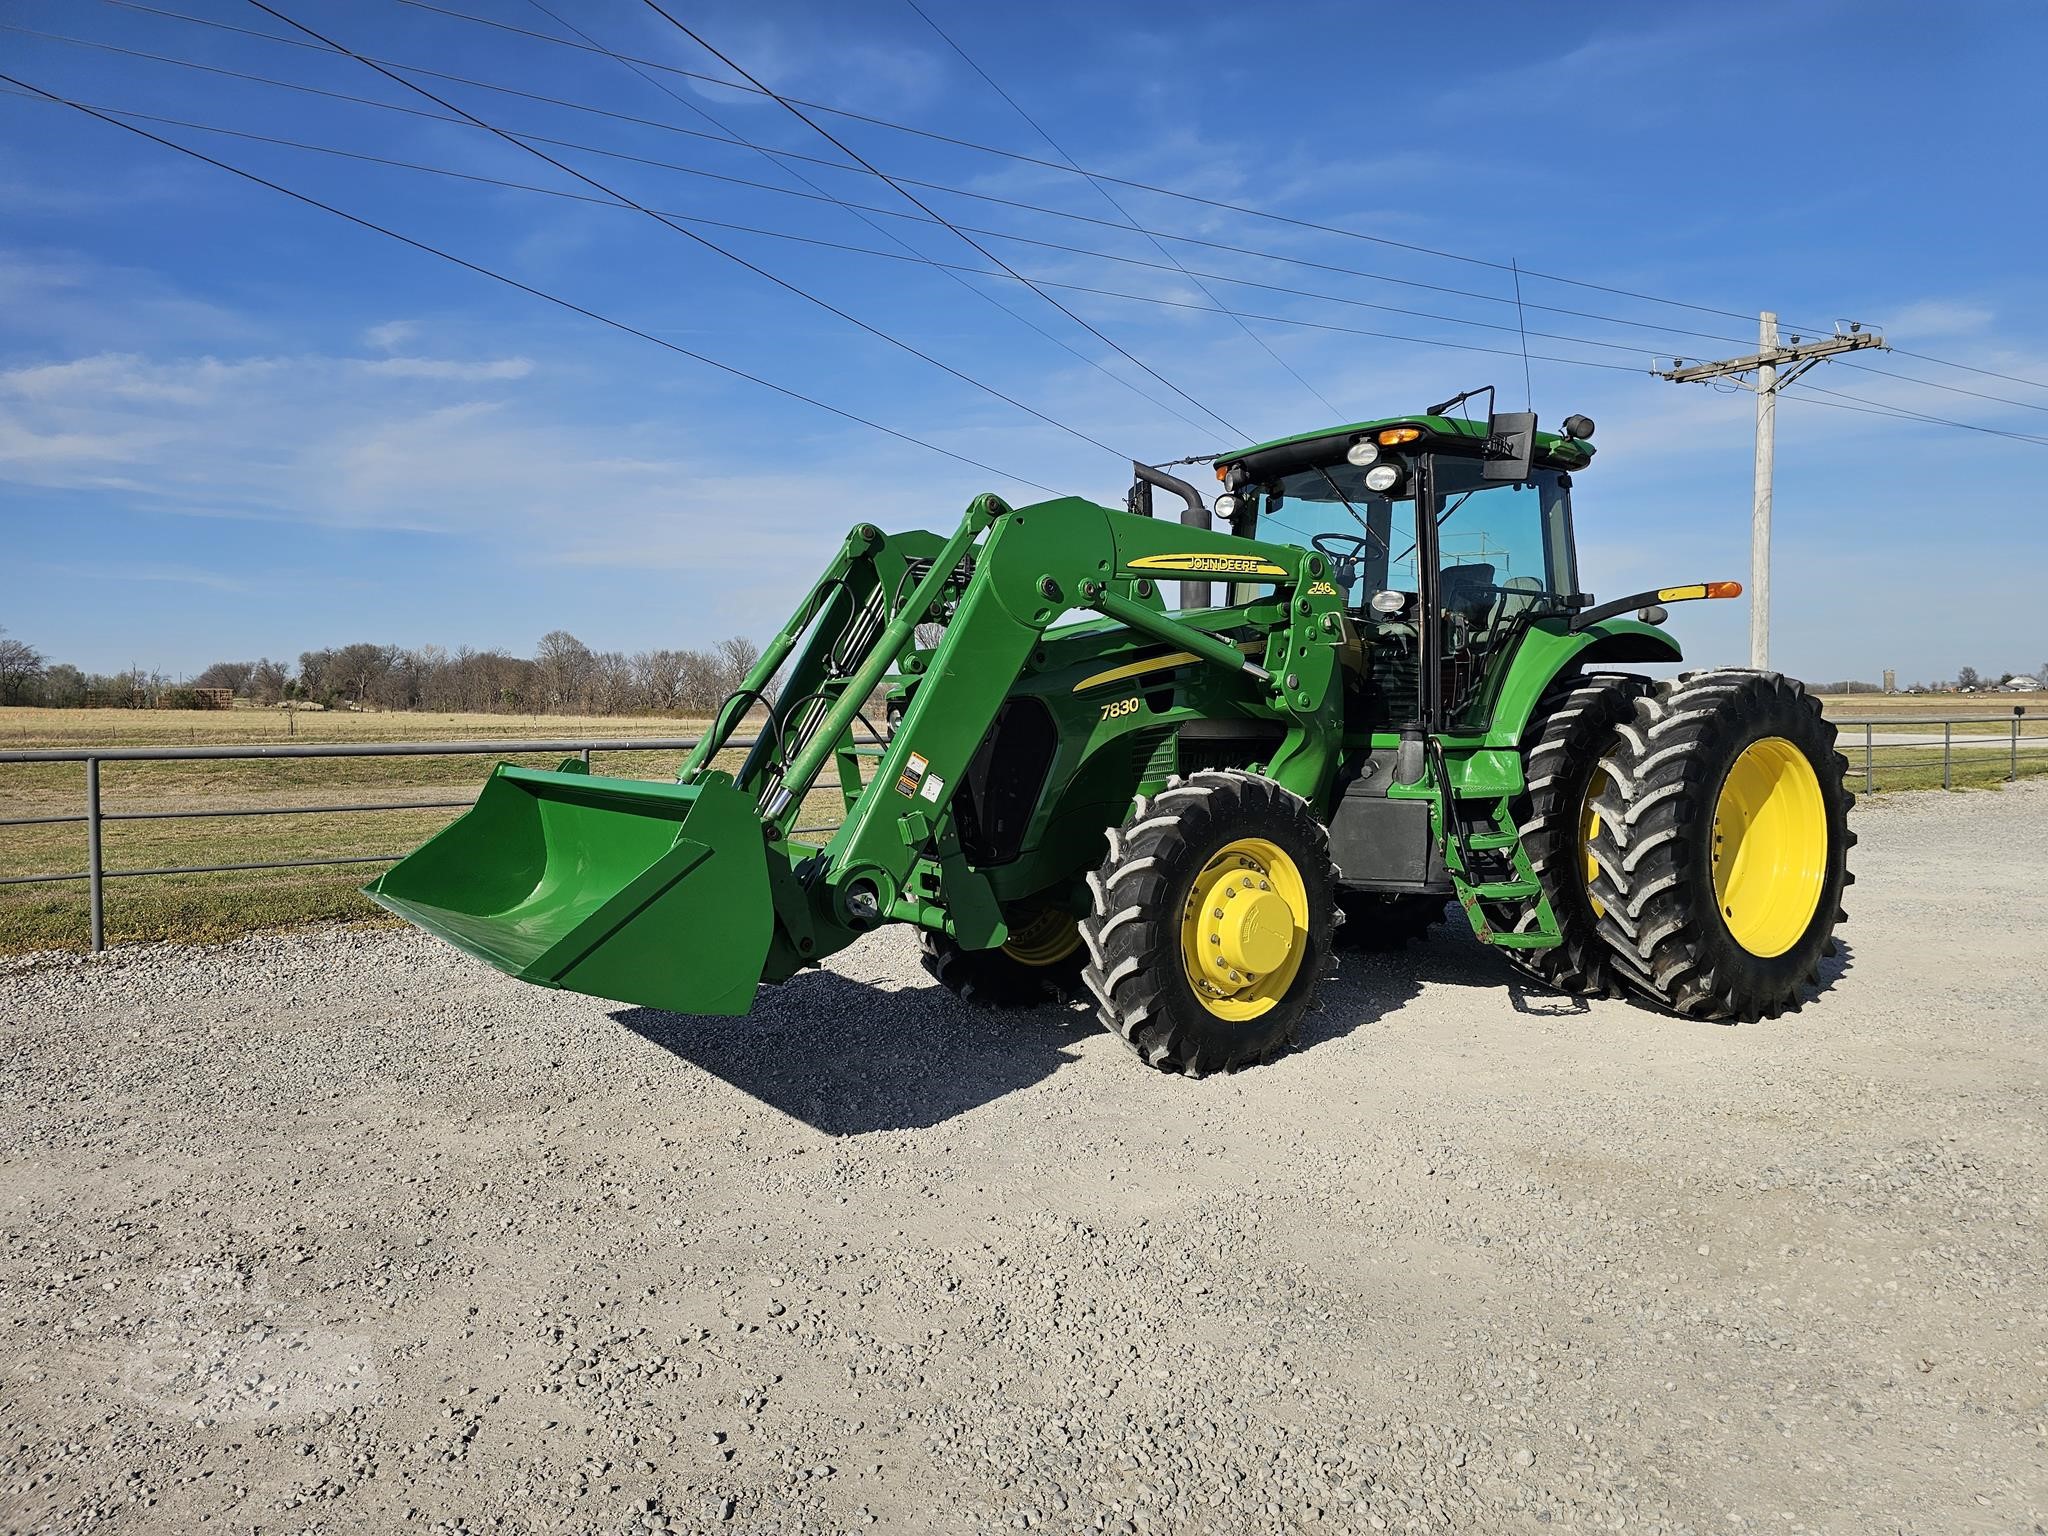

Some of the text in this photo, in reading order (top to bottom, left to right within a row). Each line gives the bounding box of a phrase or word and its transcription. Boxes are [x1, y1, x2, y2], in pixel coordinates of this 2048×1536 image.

[1188, 557, 1258, 572] JOHN DEERE
[1312, 581, 1331, 594] 746
[1100, 697, 1139, 721] 7830
